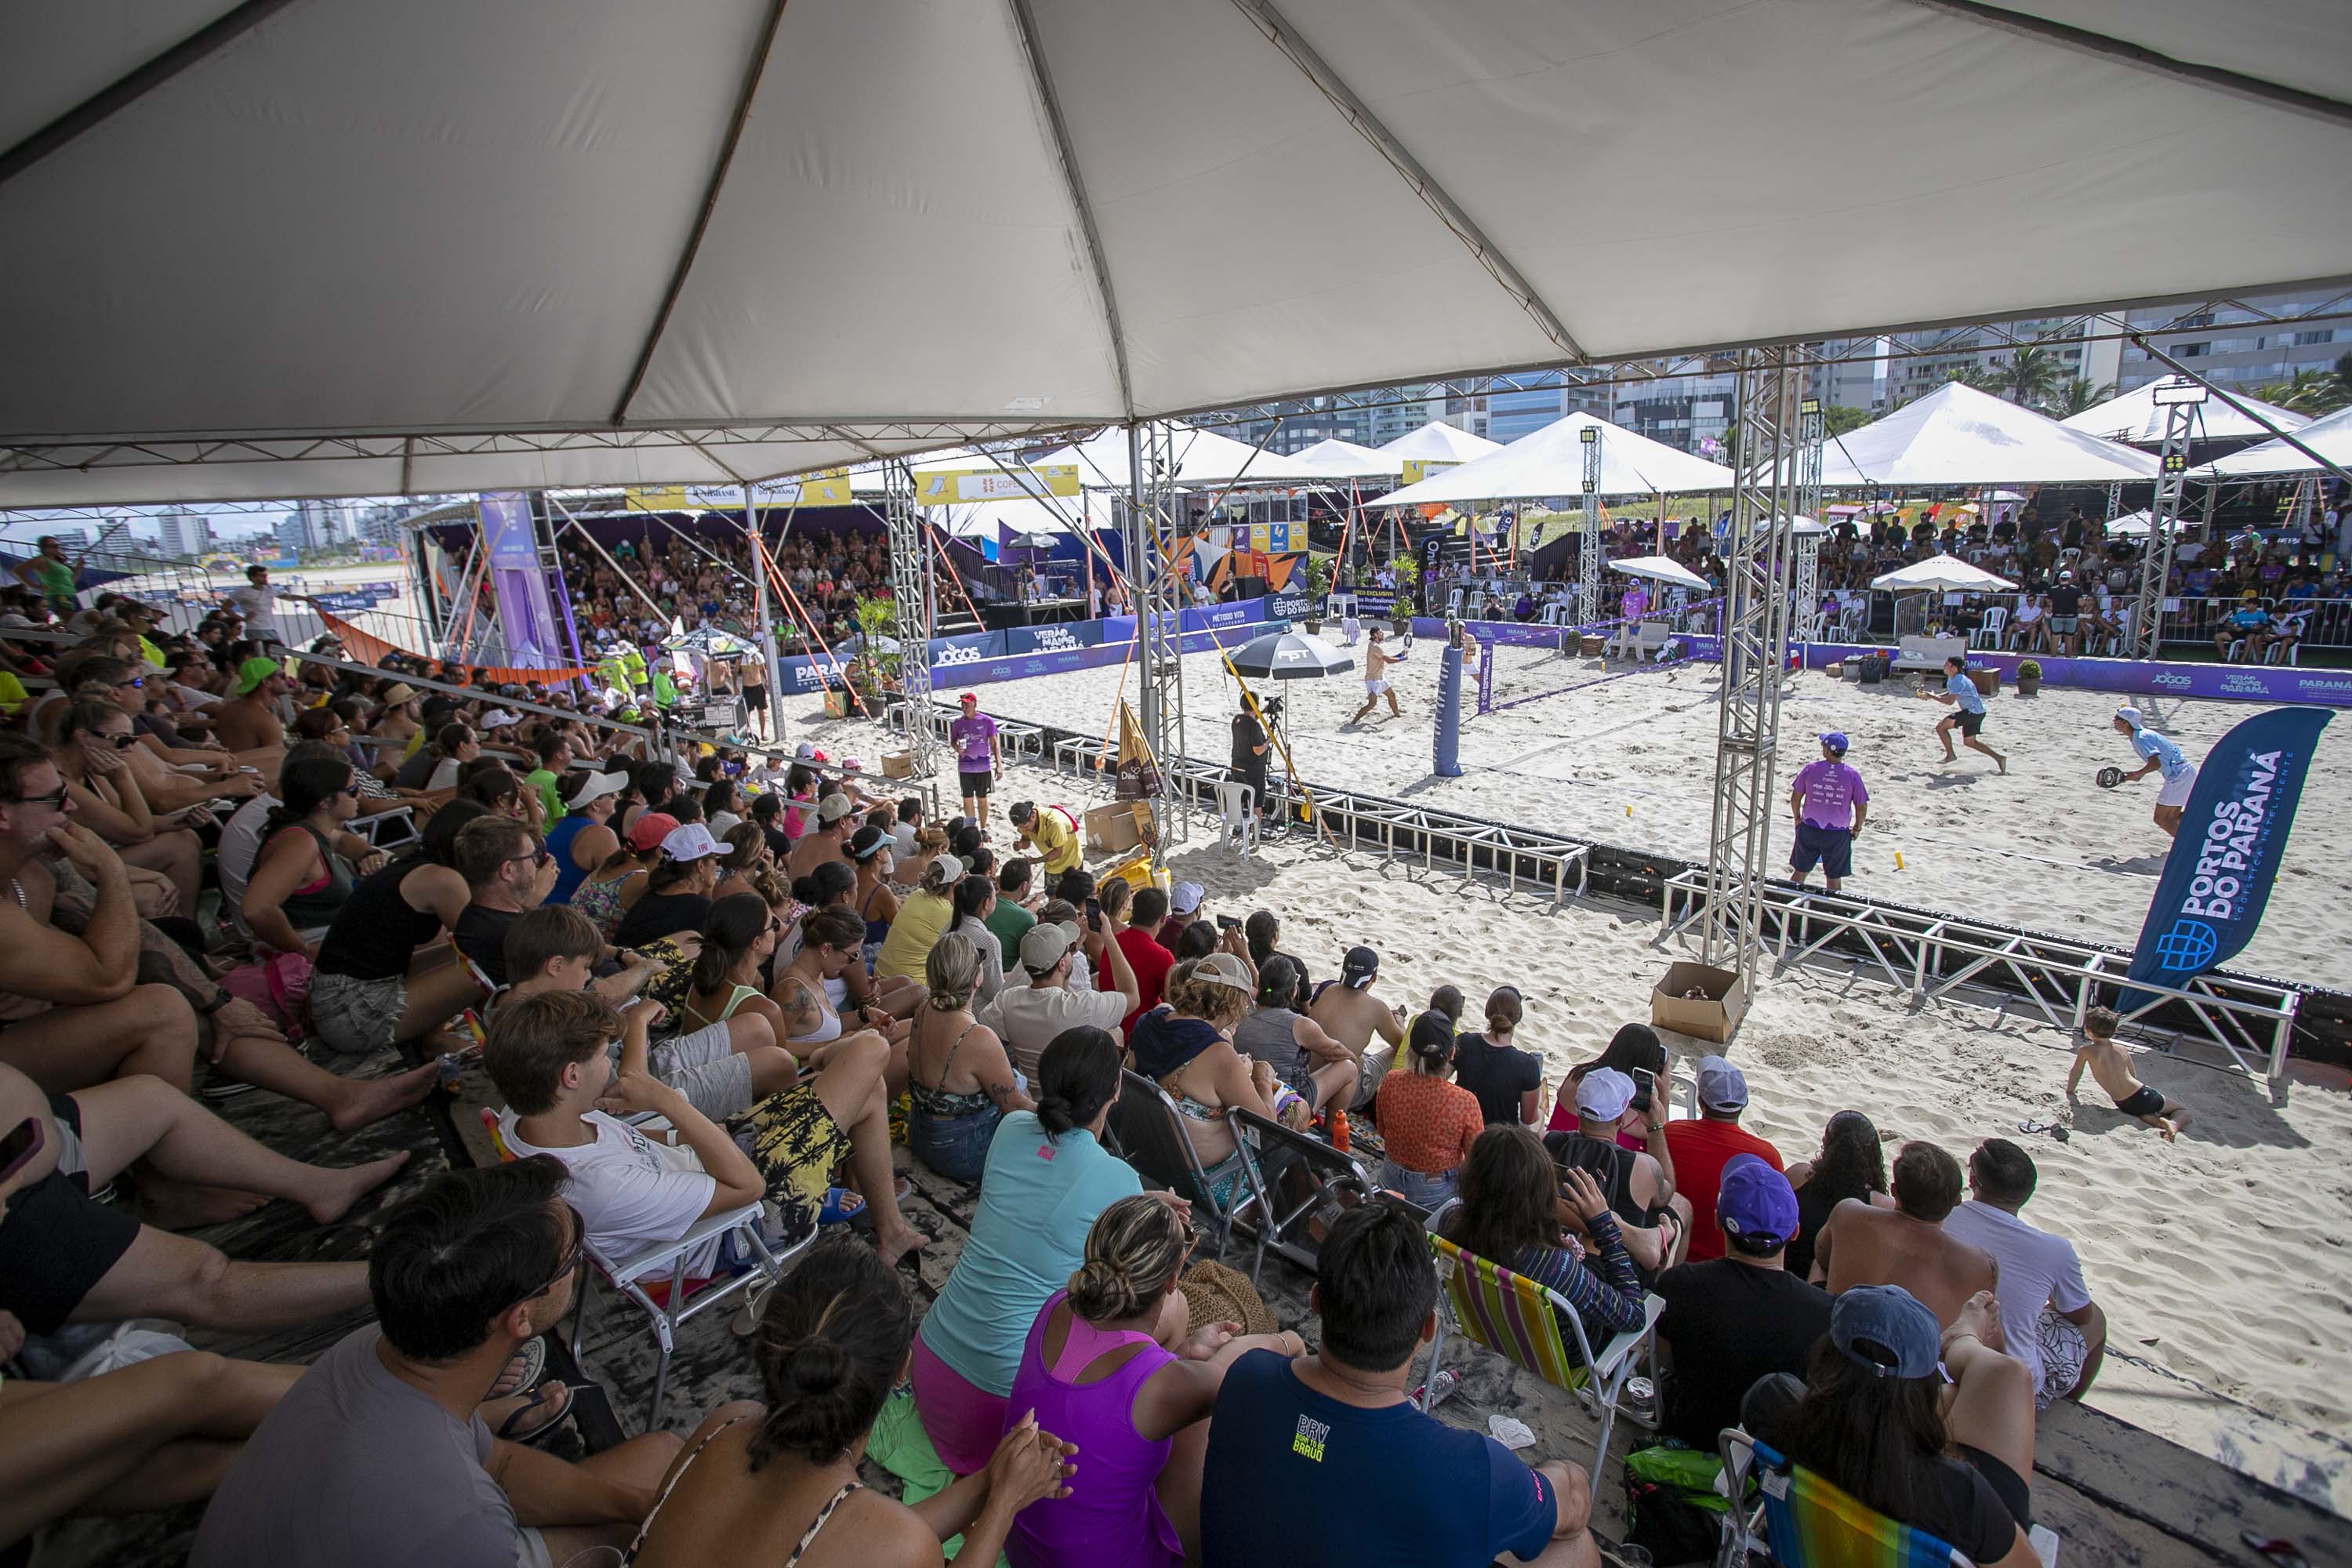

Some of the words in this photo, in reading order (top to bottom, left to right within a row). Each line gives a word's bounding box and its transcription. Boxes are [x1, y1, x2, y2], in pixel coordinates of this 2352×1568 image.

[996, 480, 1021, 489] COPE
[1287, 598, 1308, 608] PORTO
[1233, 610, 1245, 619] VITA
[1033, 626, 1068, 641] VERÃO
[1042, 635, 1076, 647] MAIOR
[935, 645, 981, 664] JOGOS
[795, 661, 849, 680] PARAN
[2151, 673, 2192, 685] JOGOS
[2299, 679, 2351, 689] PARANÁ
[2220, 684, 2270, 694] PARANÁ
[2261, 751, 2294, 842] INTELIGENTE
[2205, 875, 2241, 920] DO
[2227, 750, 2282, 872] PARANÁ
[2180, 800, 2241, 916] PORTOS
[1297, 1414, 1330, 1443] BRV
[1310, 1439, 1317, 1448] TO
